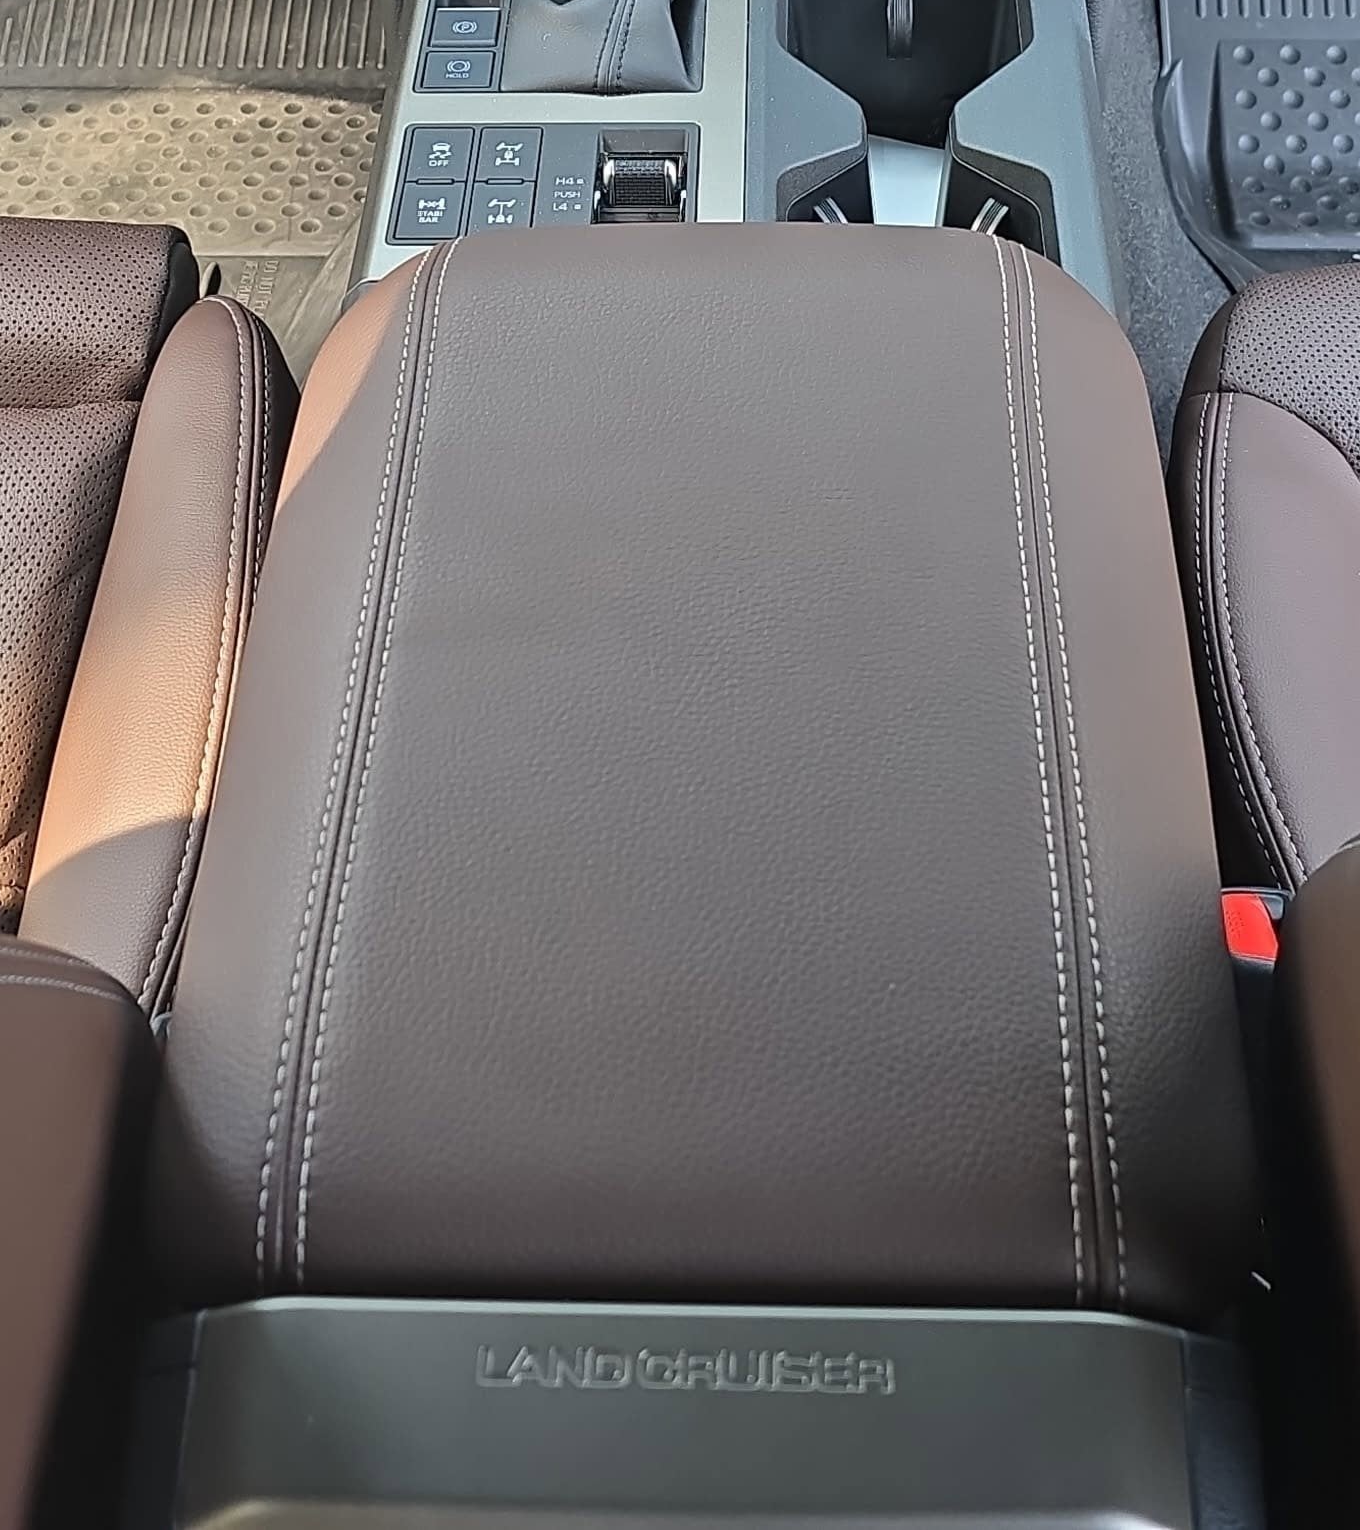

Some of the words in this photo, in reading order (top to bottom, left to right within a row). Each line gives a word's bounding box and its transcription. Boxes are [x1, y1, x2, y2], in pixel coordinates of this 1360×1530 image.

[555, 177, 575, 185] H4
[554, 191, 581, 199] PUSH
[553, 203, 568, 211] L4
[475, 1344, 632, 1390] LAND
[638, 1345, 897, 1396] CRUISER
